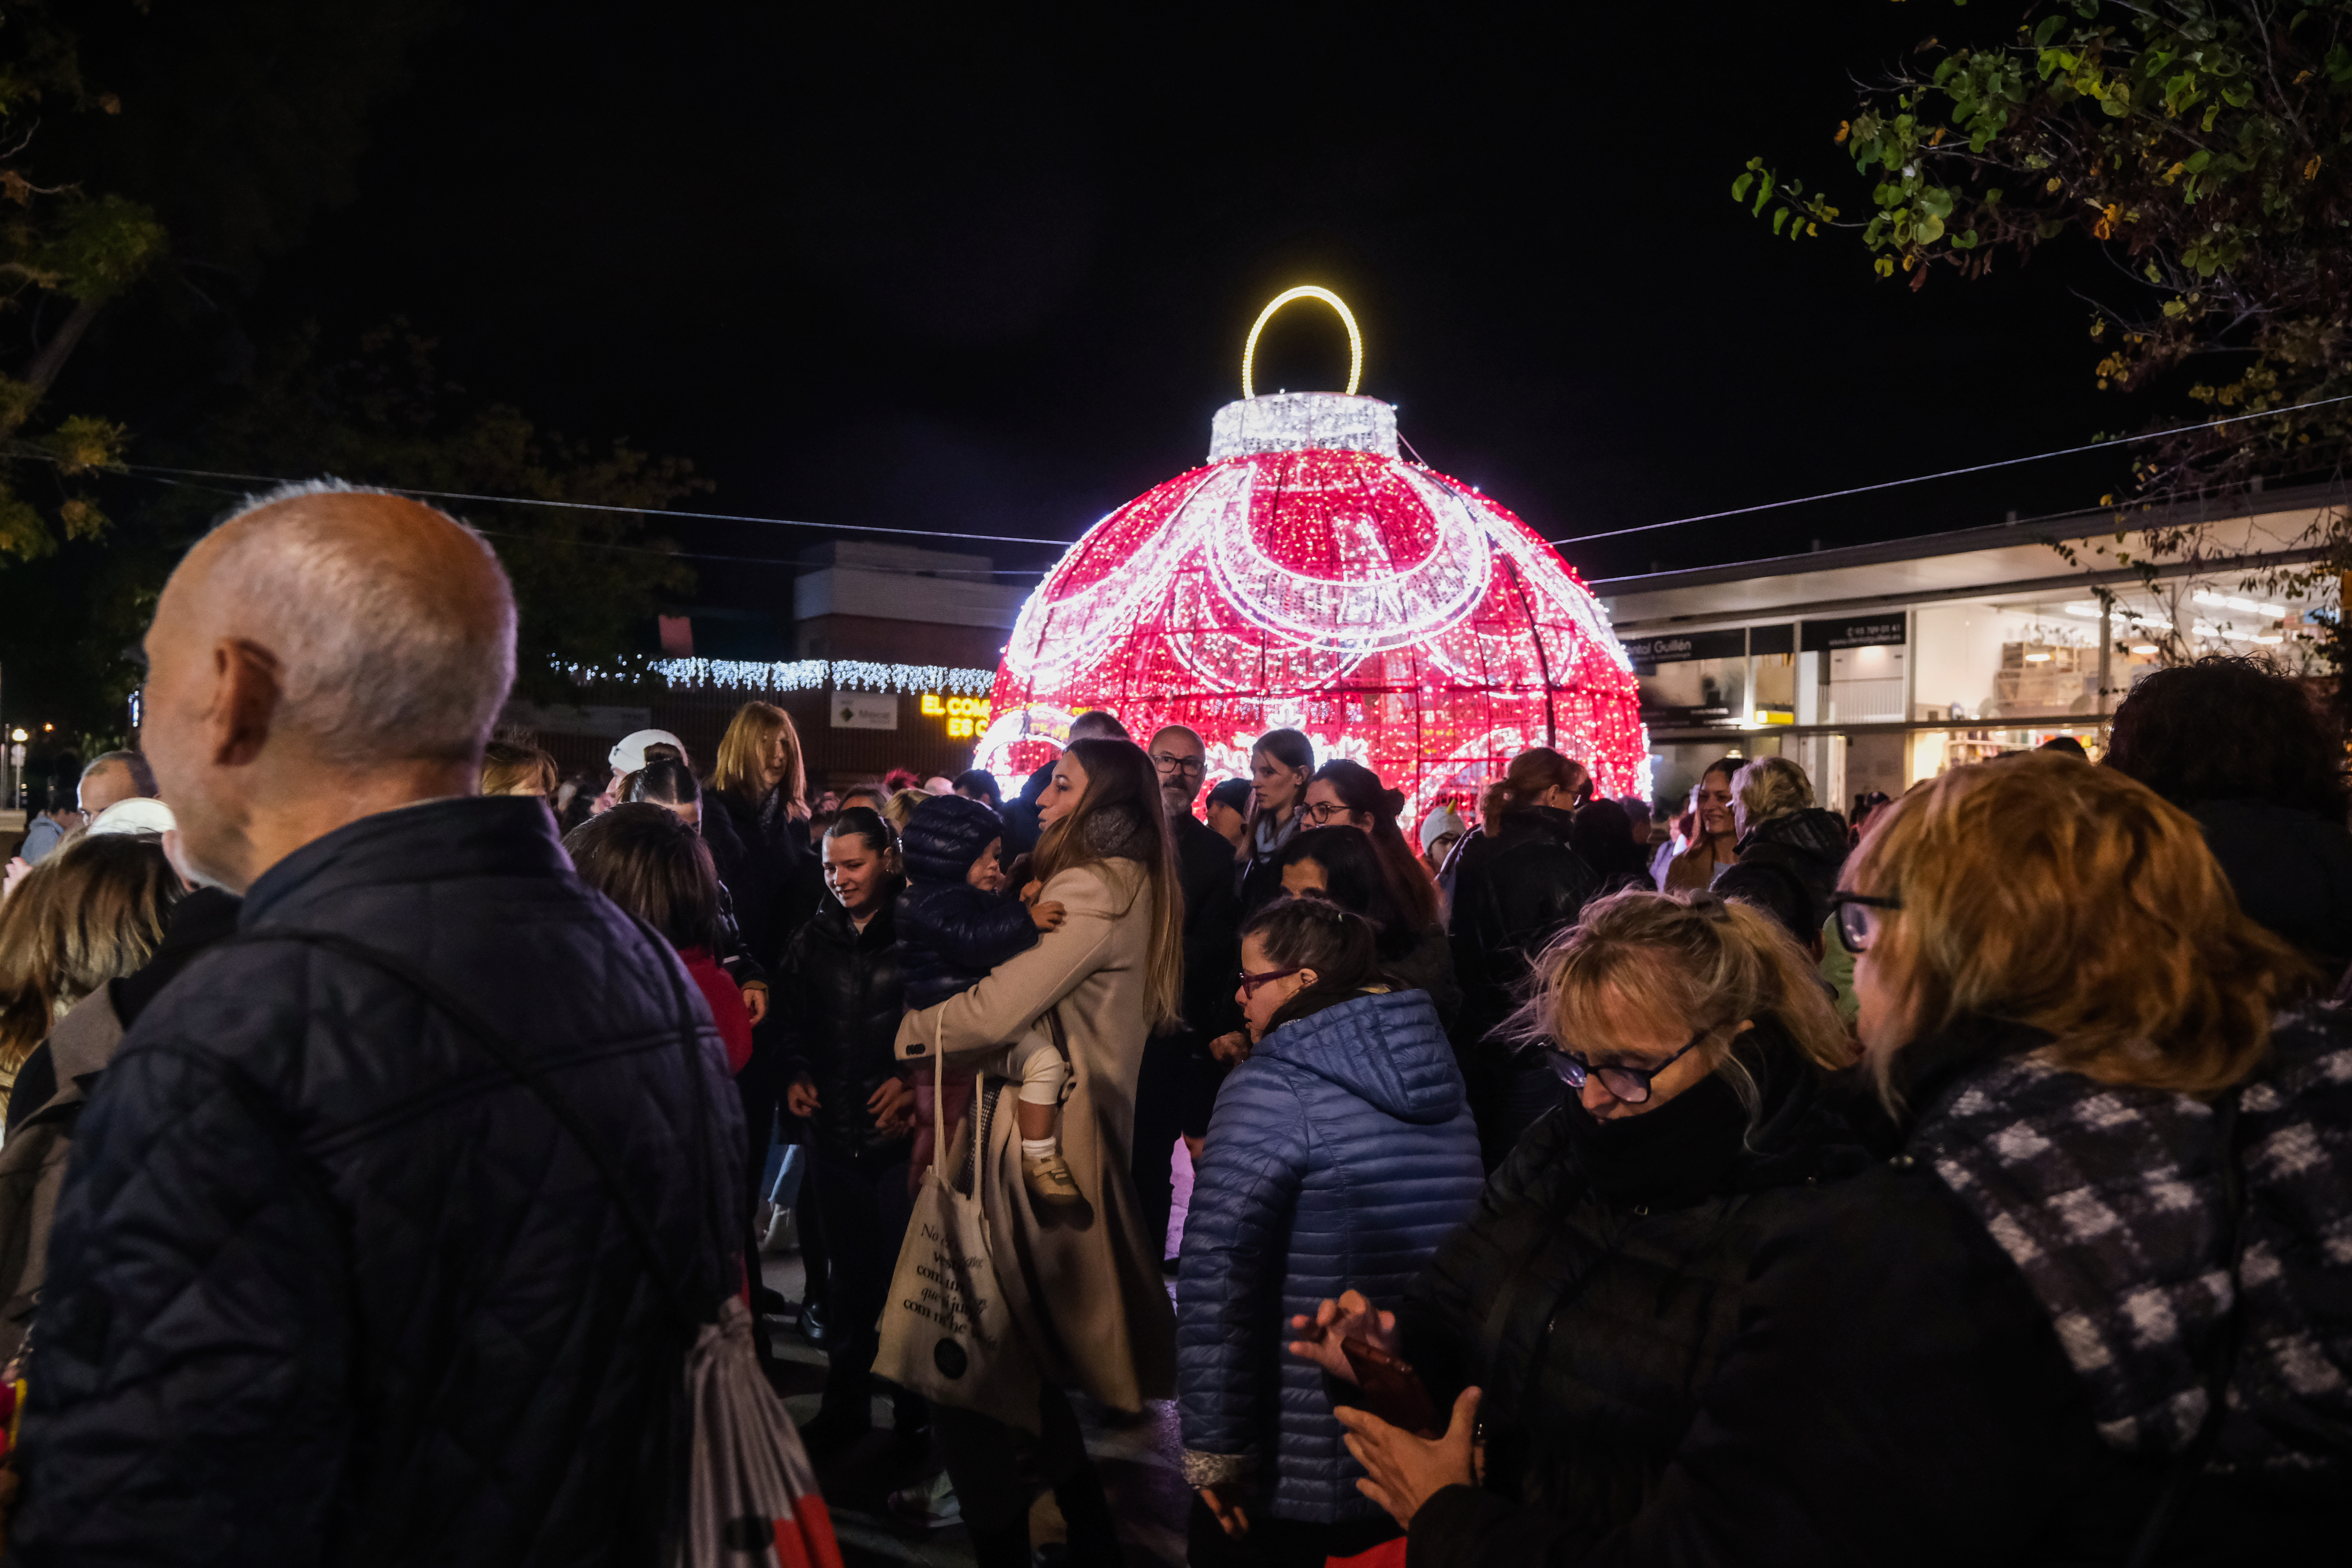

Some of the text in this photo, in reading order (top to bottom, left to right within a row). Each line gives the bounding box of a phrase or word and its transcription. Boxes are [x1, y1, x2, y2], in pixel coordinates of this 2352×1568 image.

[922, 695, 991, 717] EL COM
[948, 718, 974, 737] ES
[921, 1223, 939, 1242] No
[917, 1265, 942, 1285] com
[903, 1299, 930, 1317] com
